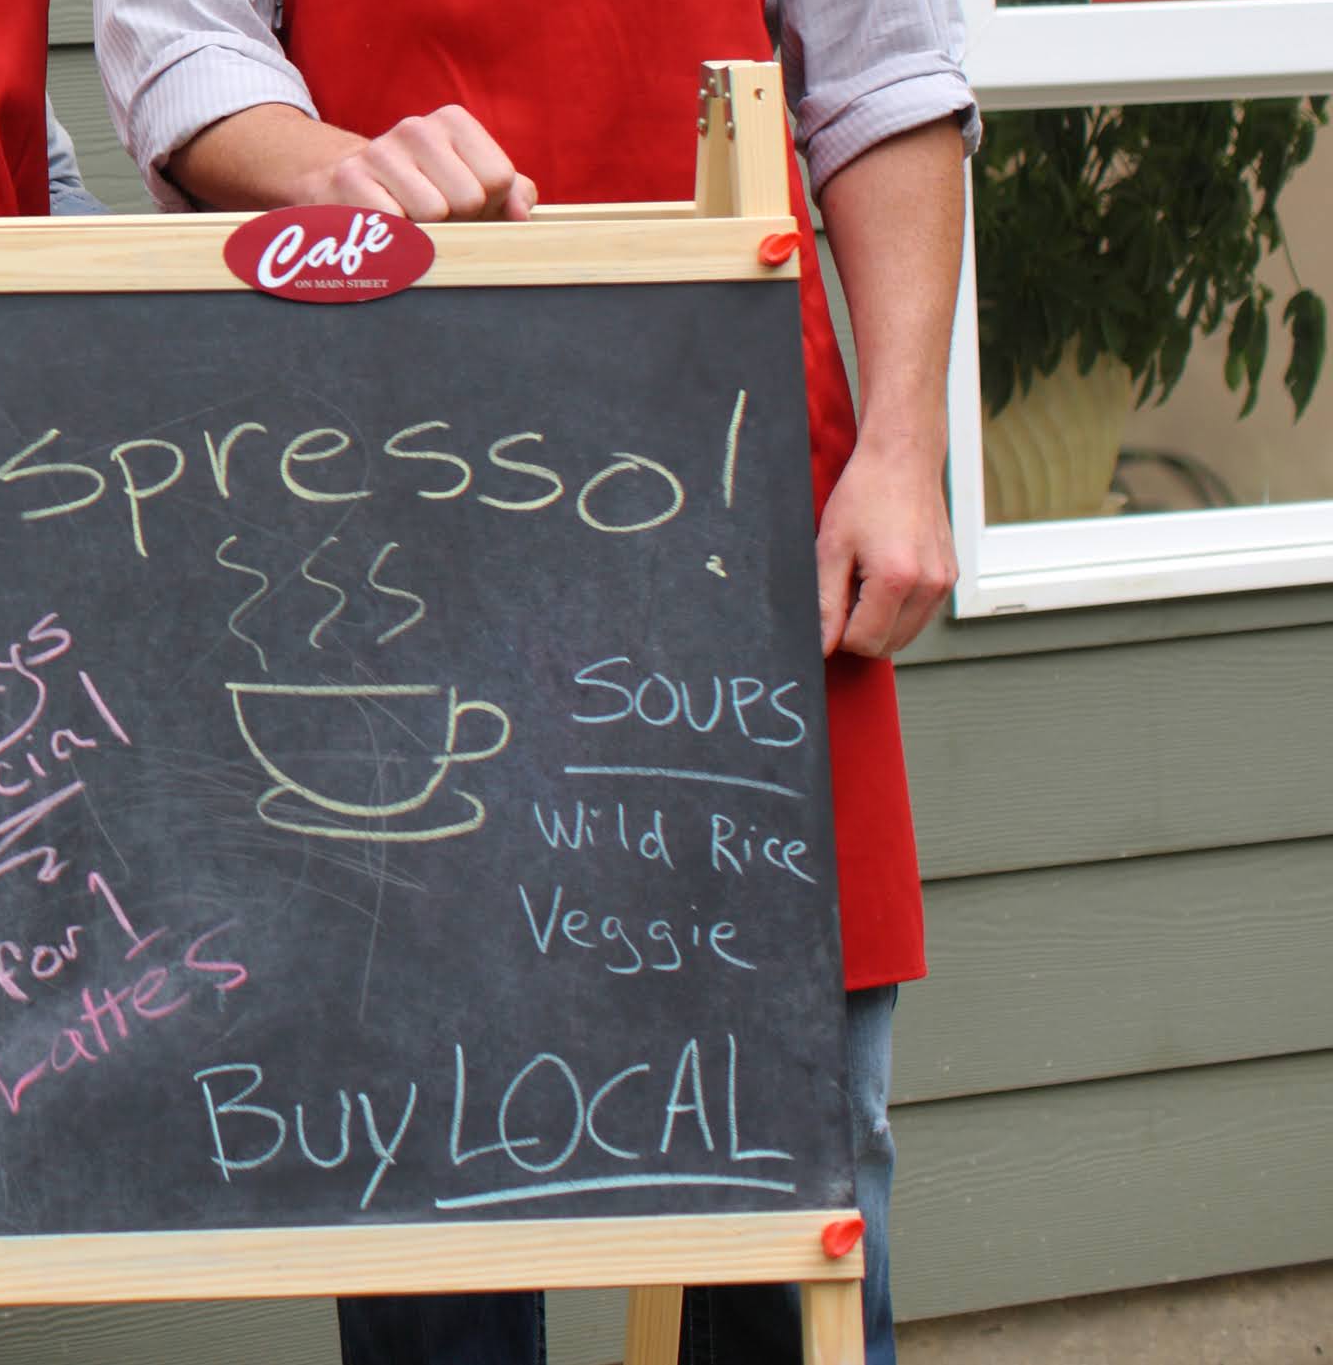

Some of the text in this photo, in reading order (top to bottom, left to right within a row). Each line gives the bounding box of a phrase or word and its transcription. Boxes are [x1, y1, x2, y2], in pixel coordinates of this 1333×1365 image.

[257, 213, 394, 288] Café
[294, 278, 389, 289] ON MAIN STREET
[534, 801, 818, 885] Wild Rice
[87, 871, 168, 961] 1
[518, 883, 758, 974] Veggie
[450, 1032, 794, 1173] LOCAL
